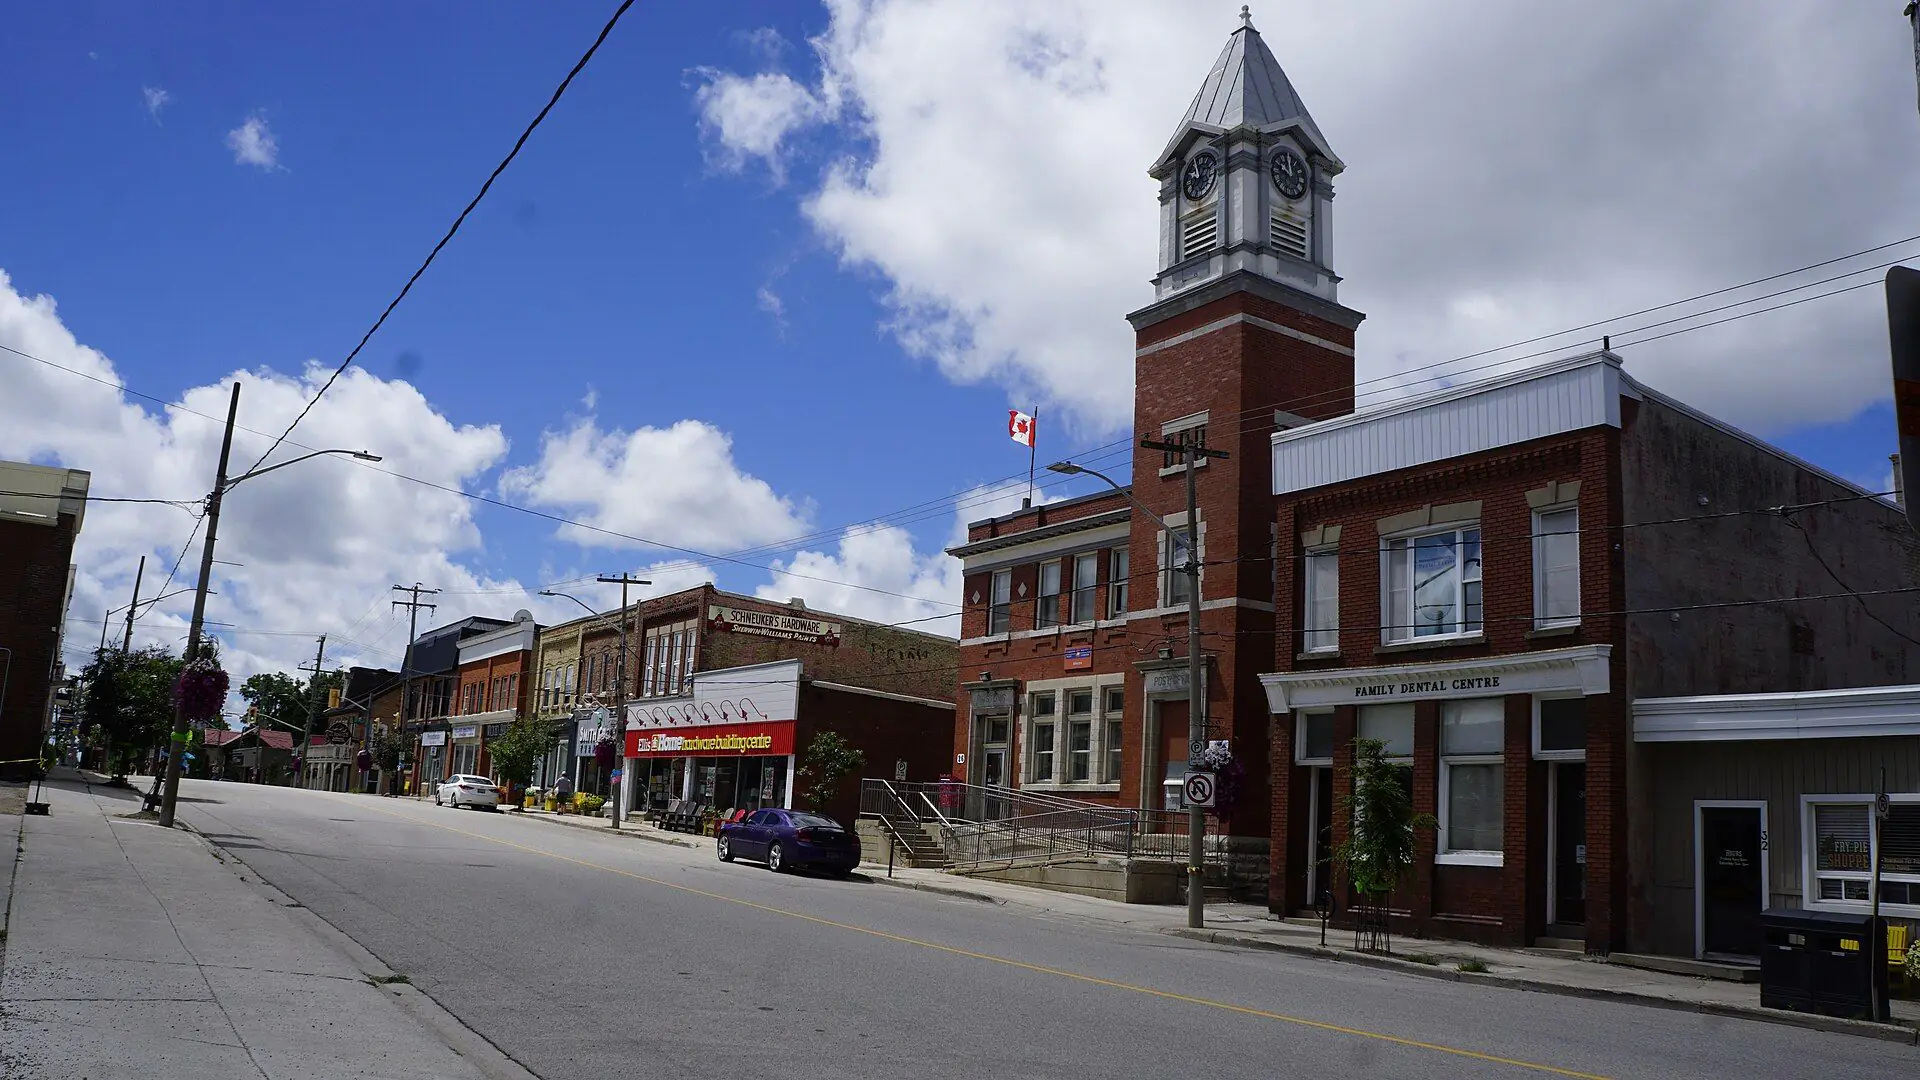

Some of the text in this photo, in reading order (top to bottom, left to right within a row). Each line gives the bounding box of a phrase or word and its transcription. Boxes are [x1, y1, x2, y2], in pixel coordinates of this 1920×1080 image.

[730, 610, 821, 633] SCHNEUKER'S HARDWARE
[1153, 676, 1171, 686] POST
[1355, 677, 1500, 696] FAMILY DENTAL CENTRE
[658, 734, 683, 751] Home
[716, 734, 747, 753] building
[747, 733, 772, 749] centre
[1854, 841, 1869, 853] PIE
[1828, 853, 1869, 869] SHOPPE
